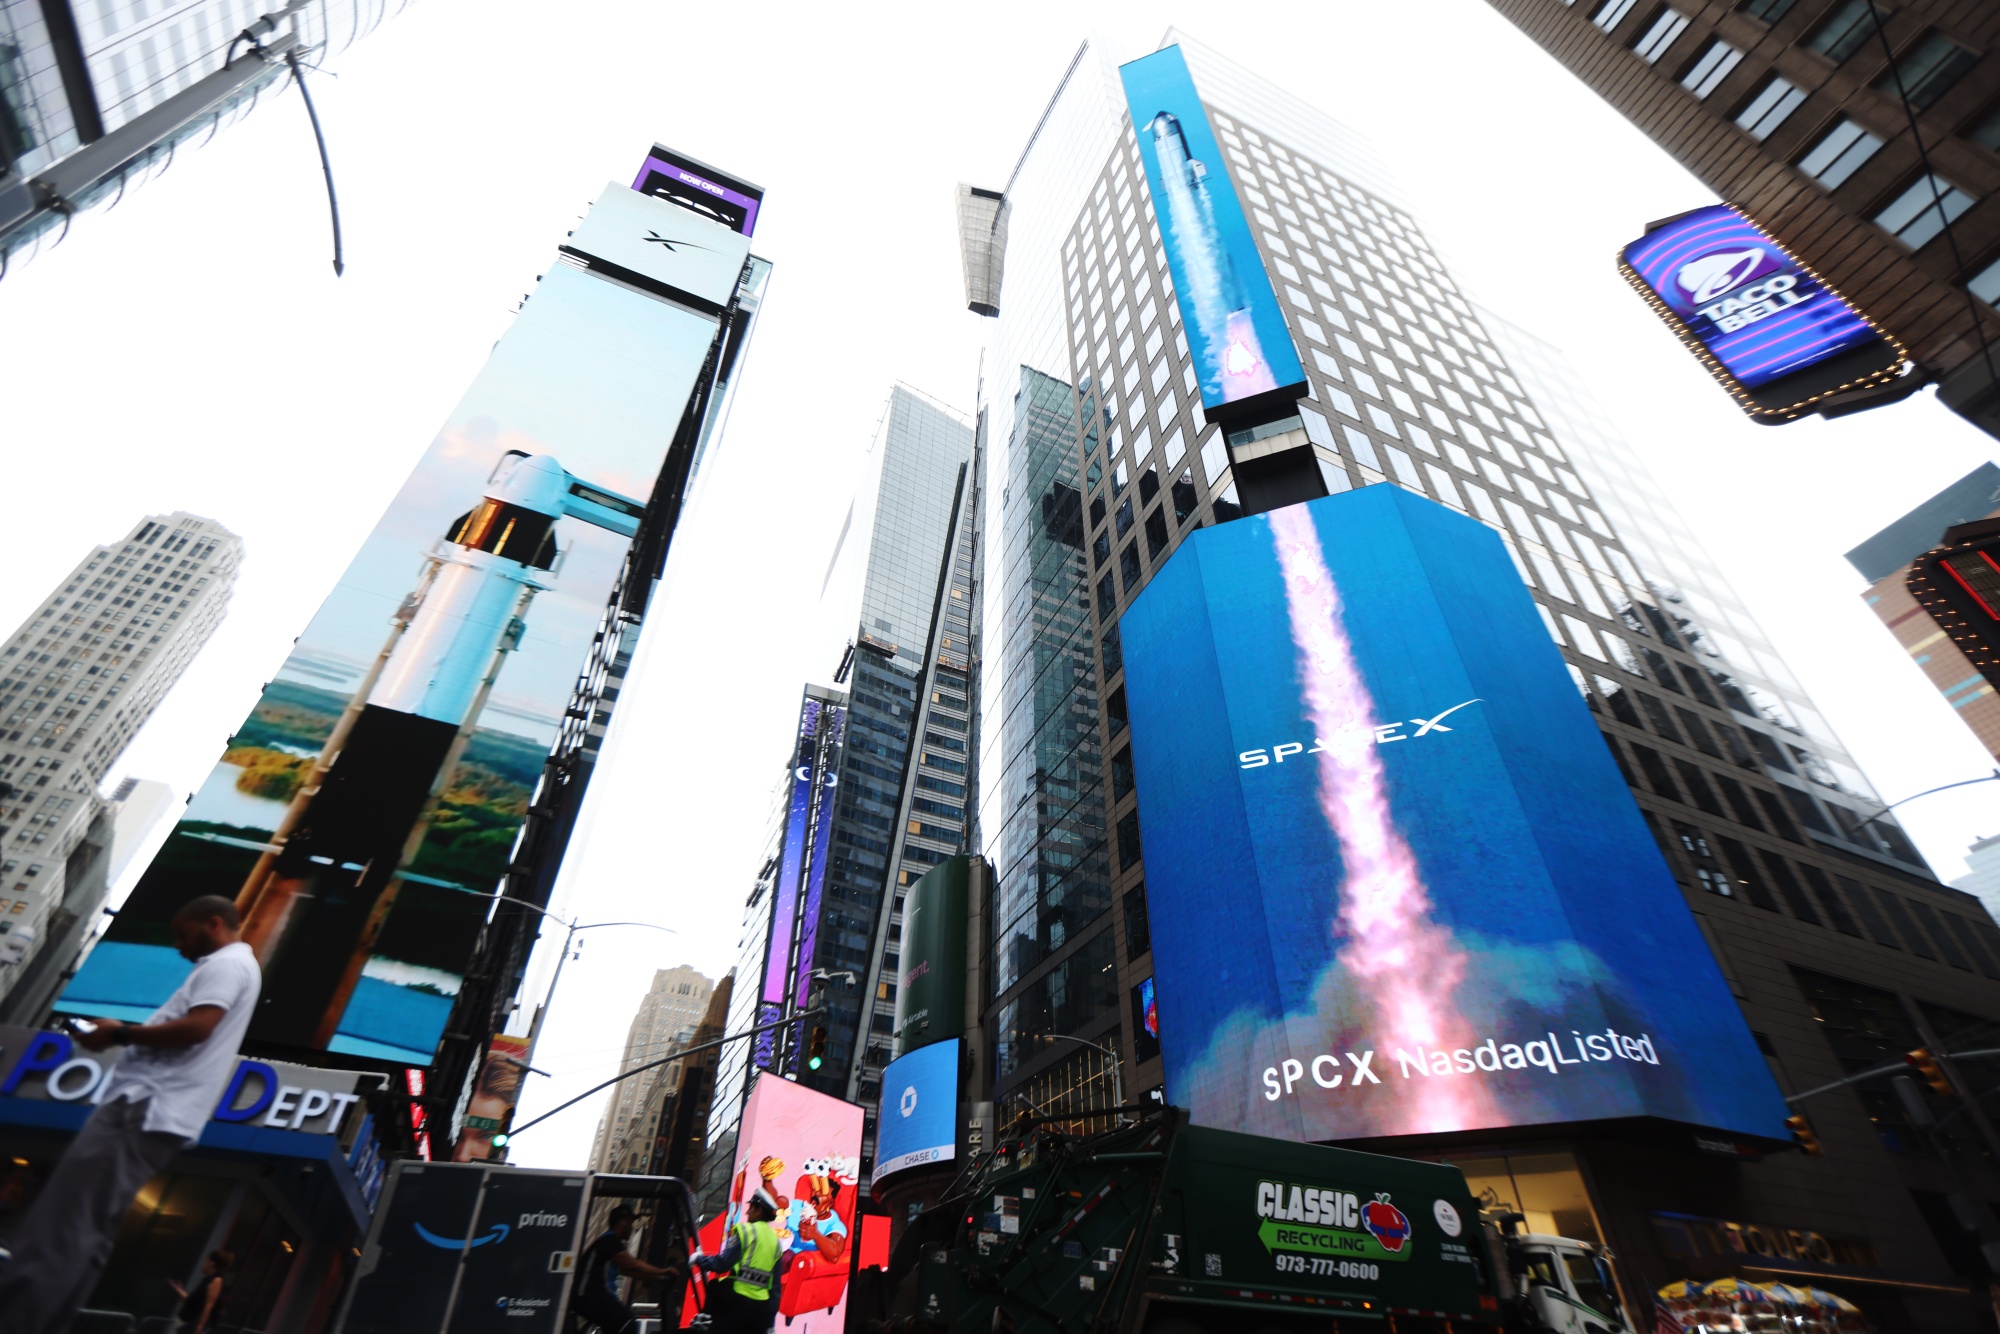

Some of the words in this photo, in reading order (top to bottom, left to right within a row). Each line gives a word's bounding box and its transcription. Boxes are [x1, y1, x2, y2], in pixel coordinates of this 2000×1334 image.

[679, 172, 702, 187] NOW
[701, 180, 725, 196] OPEN
[1695, 274, 1798, 321] TACO
[1715, 293, 1816, 335] BELL
[1239, 698, 1486, 769] SPAEX
[1262, 1050, 1382, 1102] SPCX
[1398, 1028, 1661, 1080] NasdaqListed
[213, 1060, 360, 1134] DEPT
[904, 1151, 931, 1166] CHASE
[517, 1210, 569, 1230] prime
[1257, 1181, 1359, 1229] CLASSIC
[1276, 1229, 1366, 1253] RECYCLING
[1275, 1254, 1380, 1281] 973-777-0600
